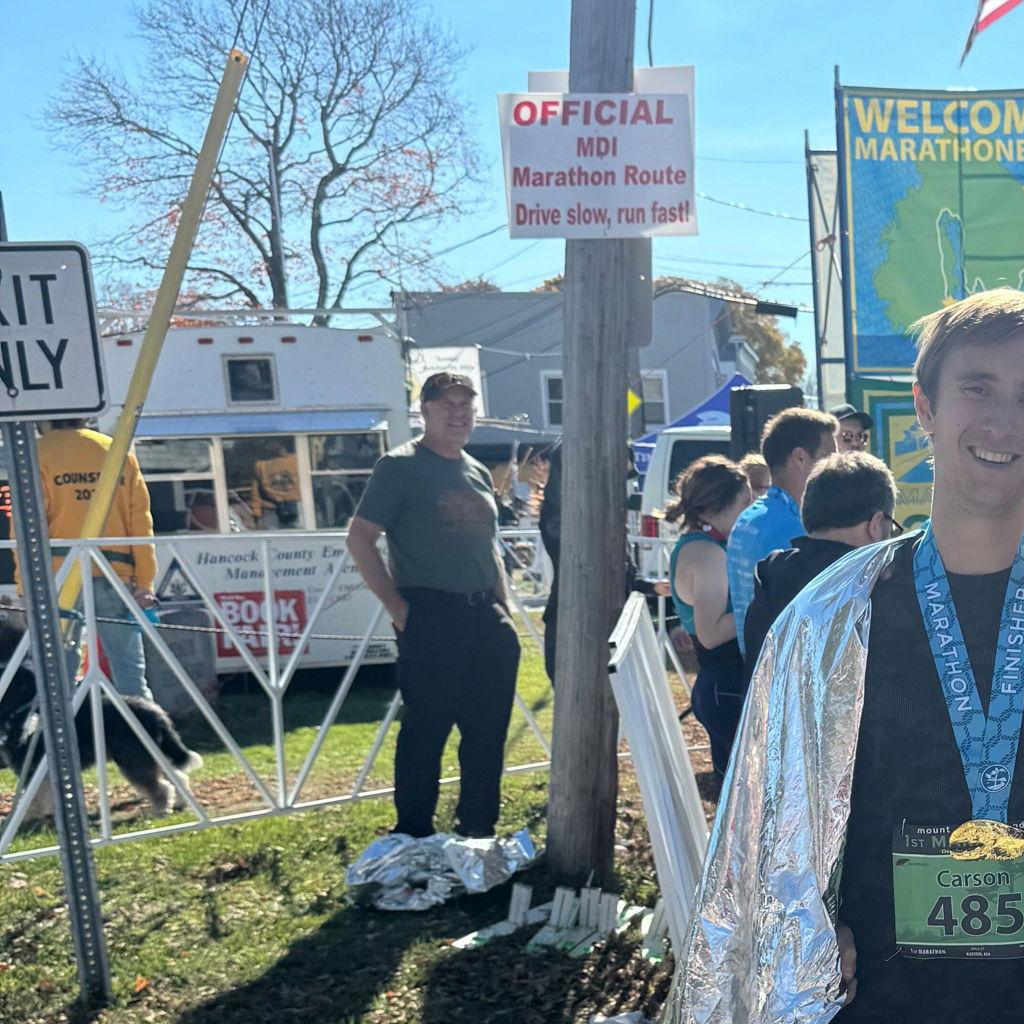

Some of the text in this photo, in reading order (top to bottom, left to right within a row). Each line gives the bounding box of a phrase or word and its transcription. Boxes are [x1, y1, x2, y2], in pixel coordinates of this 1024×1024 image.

[513, 99, 674, 127] OFFICIAL
[576, 136, 618, 158] MDI
[512, 165, 687, 187] Marathon Route
[515, 201, 690, 229] Drive slow, run fast!
[0, 273, 57, 326] IT
[0, 337, 69, 391] NLY
[53, 471, 126, 487] COUNSR
[74, 488, 96, 502] 20
[197, 551, 259, 565] Hancock
[225, 565, 316, 580] Manaement
[924, 582, 972, 712] MARATHON
[917, 826, 951, 835] mount
[937, 870, 1011, 888] Carson
[927, 891, 1024, 937] 485
